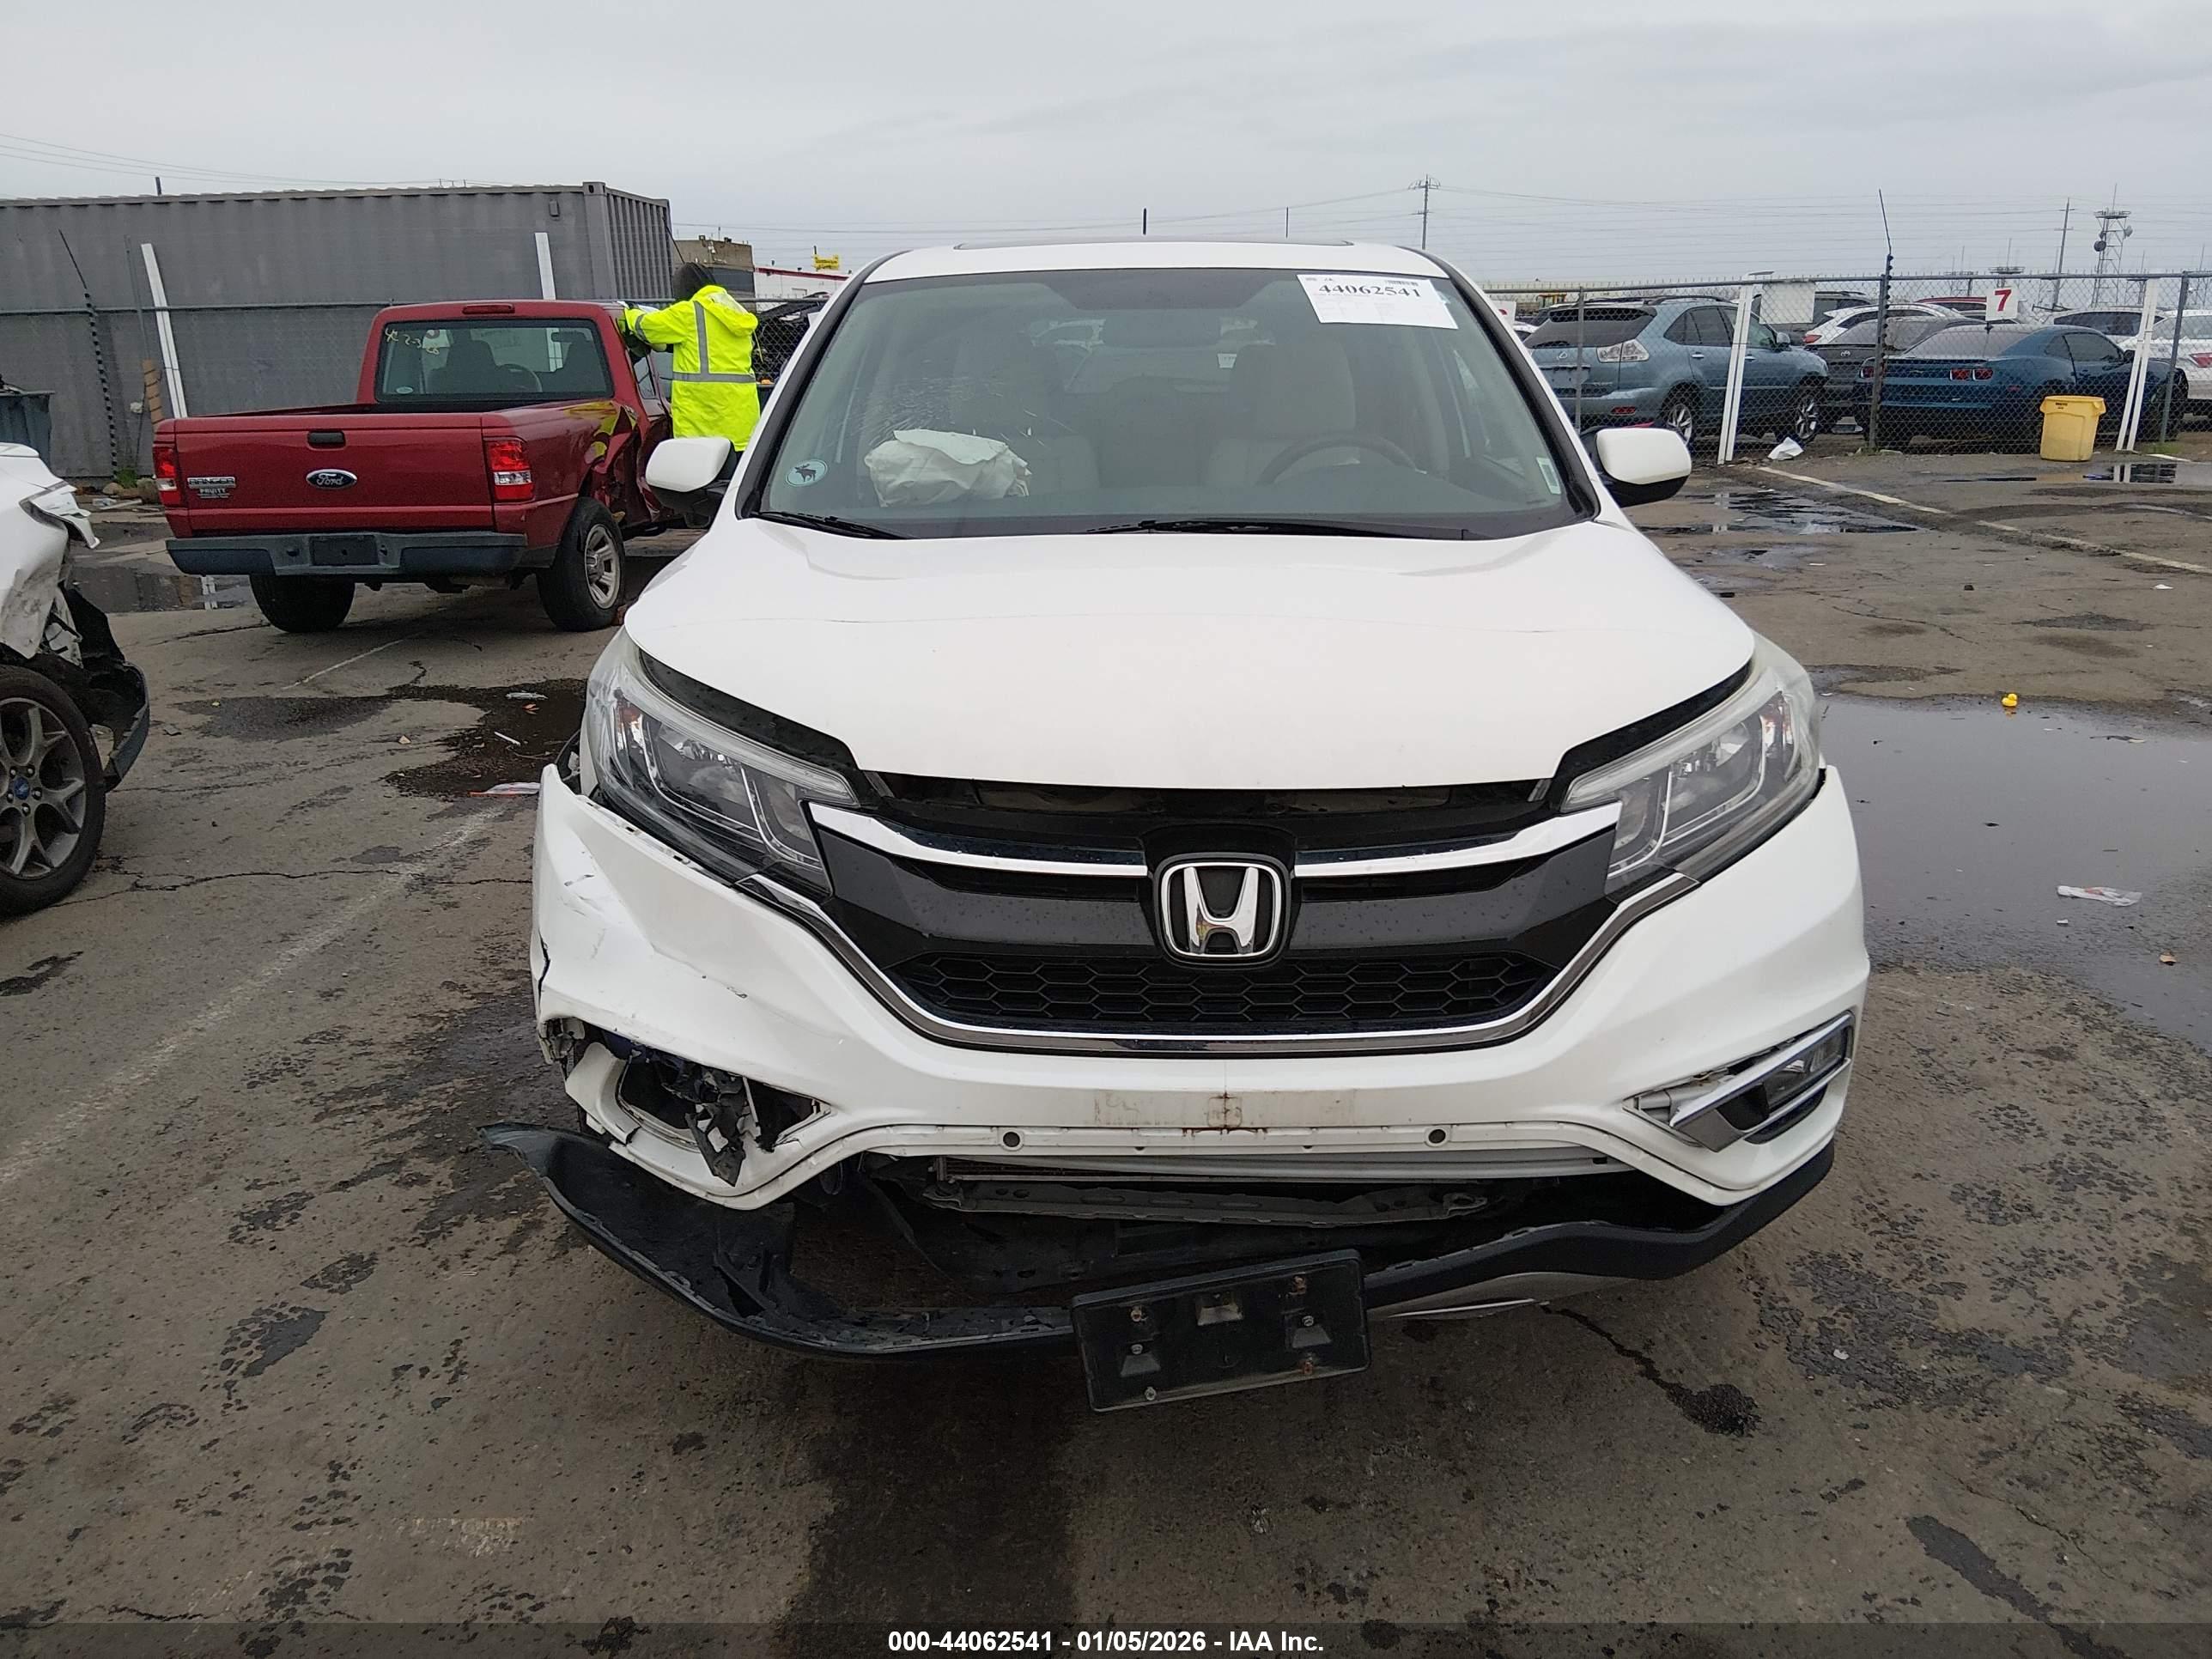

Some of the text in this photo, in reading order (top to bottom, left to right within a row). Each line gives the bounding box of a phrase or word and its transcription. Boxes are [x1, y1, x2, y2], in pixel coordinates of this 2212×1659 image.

[1319, 284, 1421, 297] 44062541
[1994, 289, 2012, 312] 7
[316, 472, 343, 486] Ford
